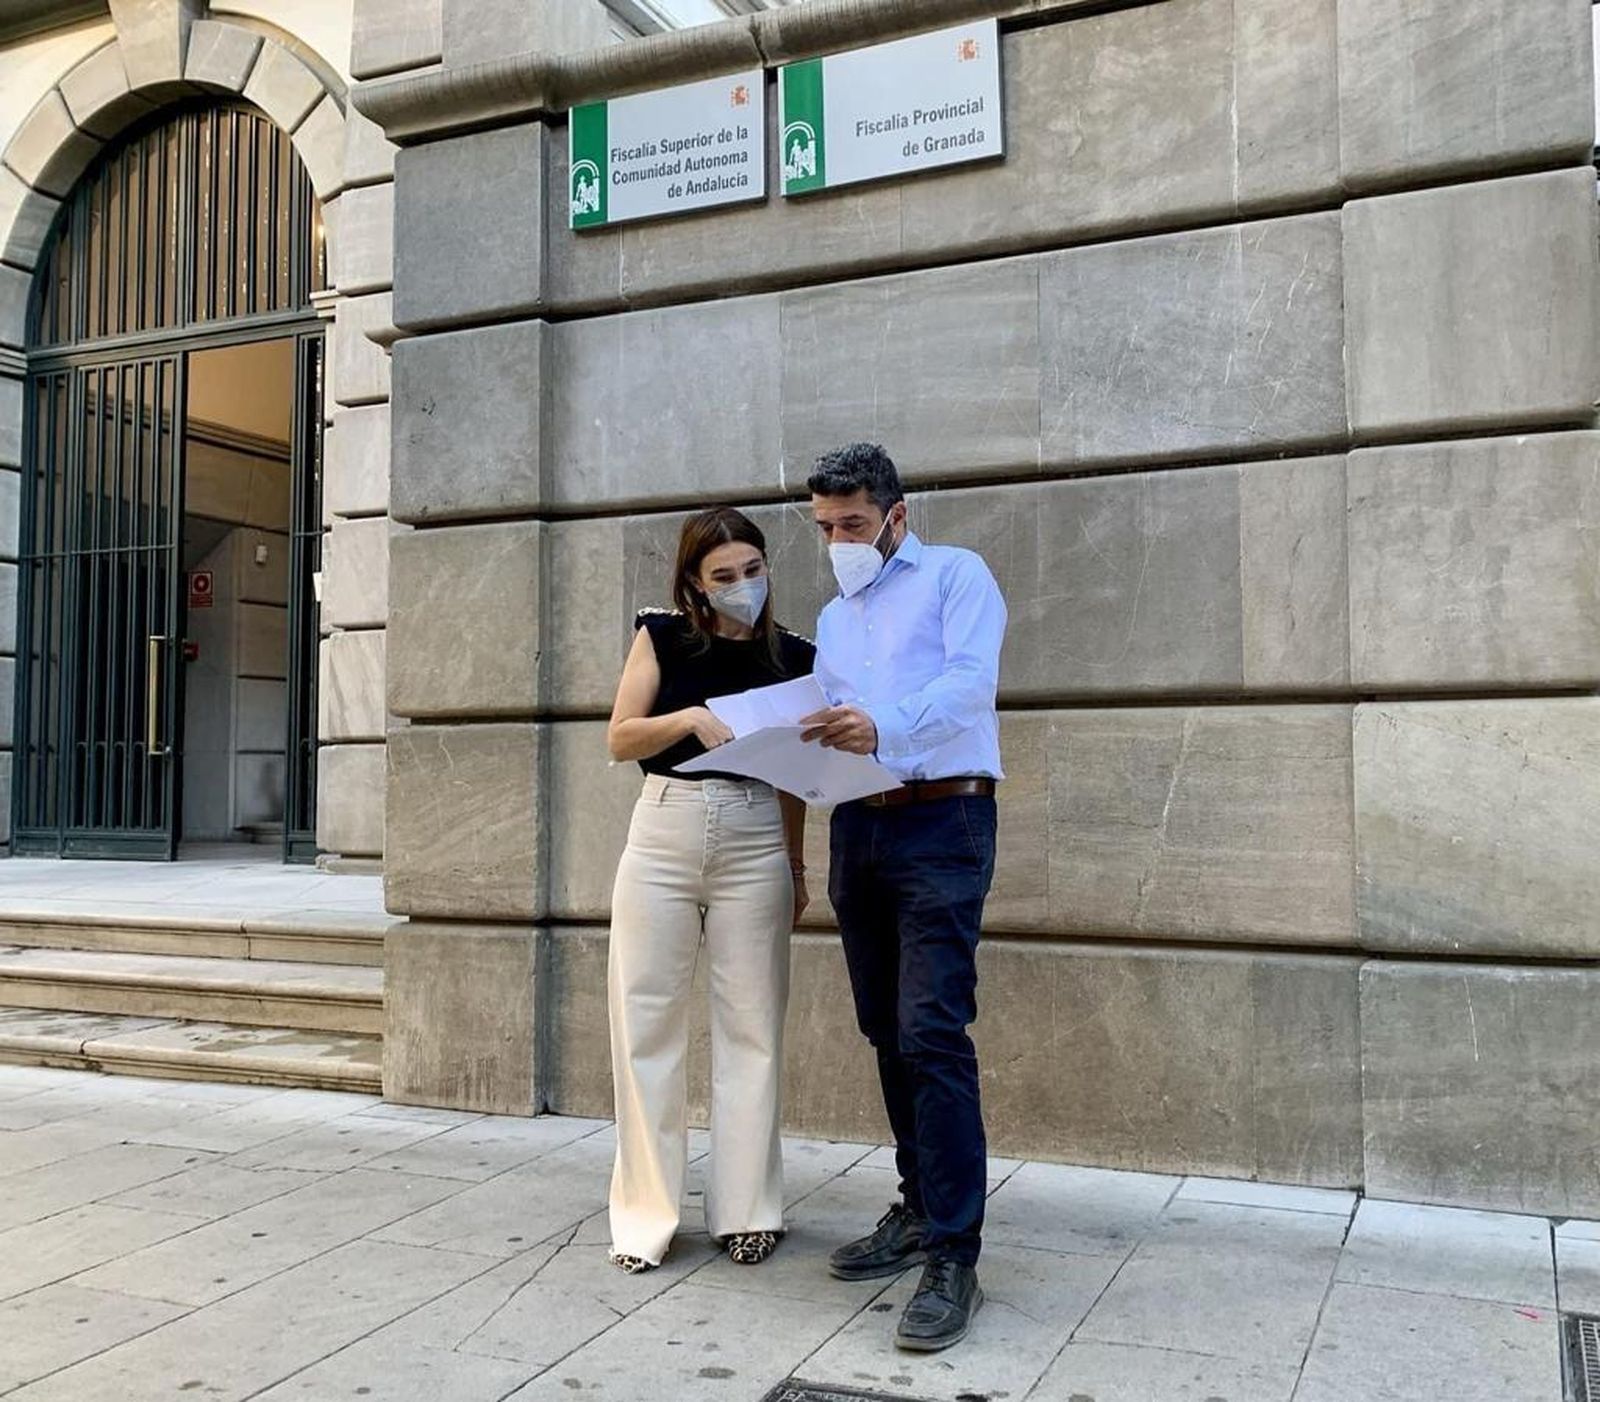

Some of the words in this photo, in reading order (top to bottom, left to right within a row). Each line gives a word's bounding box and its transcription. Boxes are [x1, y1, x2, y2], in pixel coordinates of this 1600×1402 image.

[913, 96, 984, 125] Provincial
[660, 133, 714, 155] Superior
[717, 128, 733, 143] de
[736, 125, 749, 140] la
[902, 141, 920, 157] de
[923, 128, 985, 153] Granada
[612, 160, 681, 185] Comunidad
[667, 183, 682, 198] de
